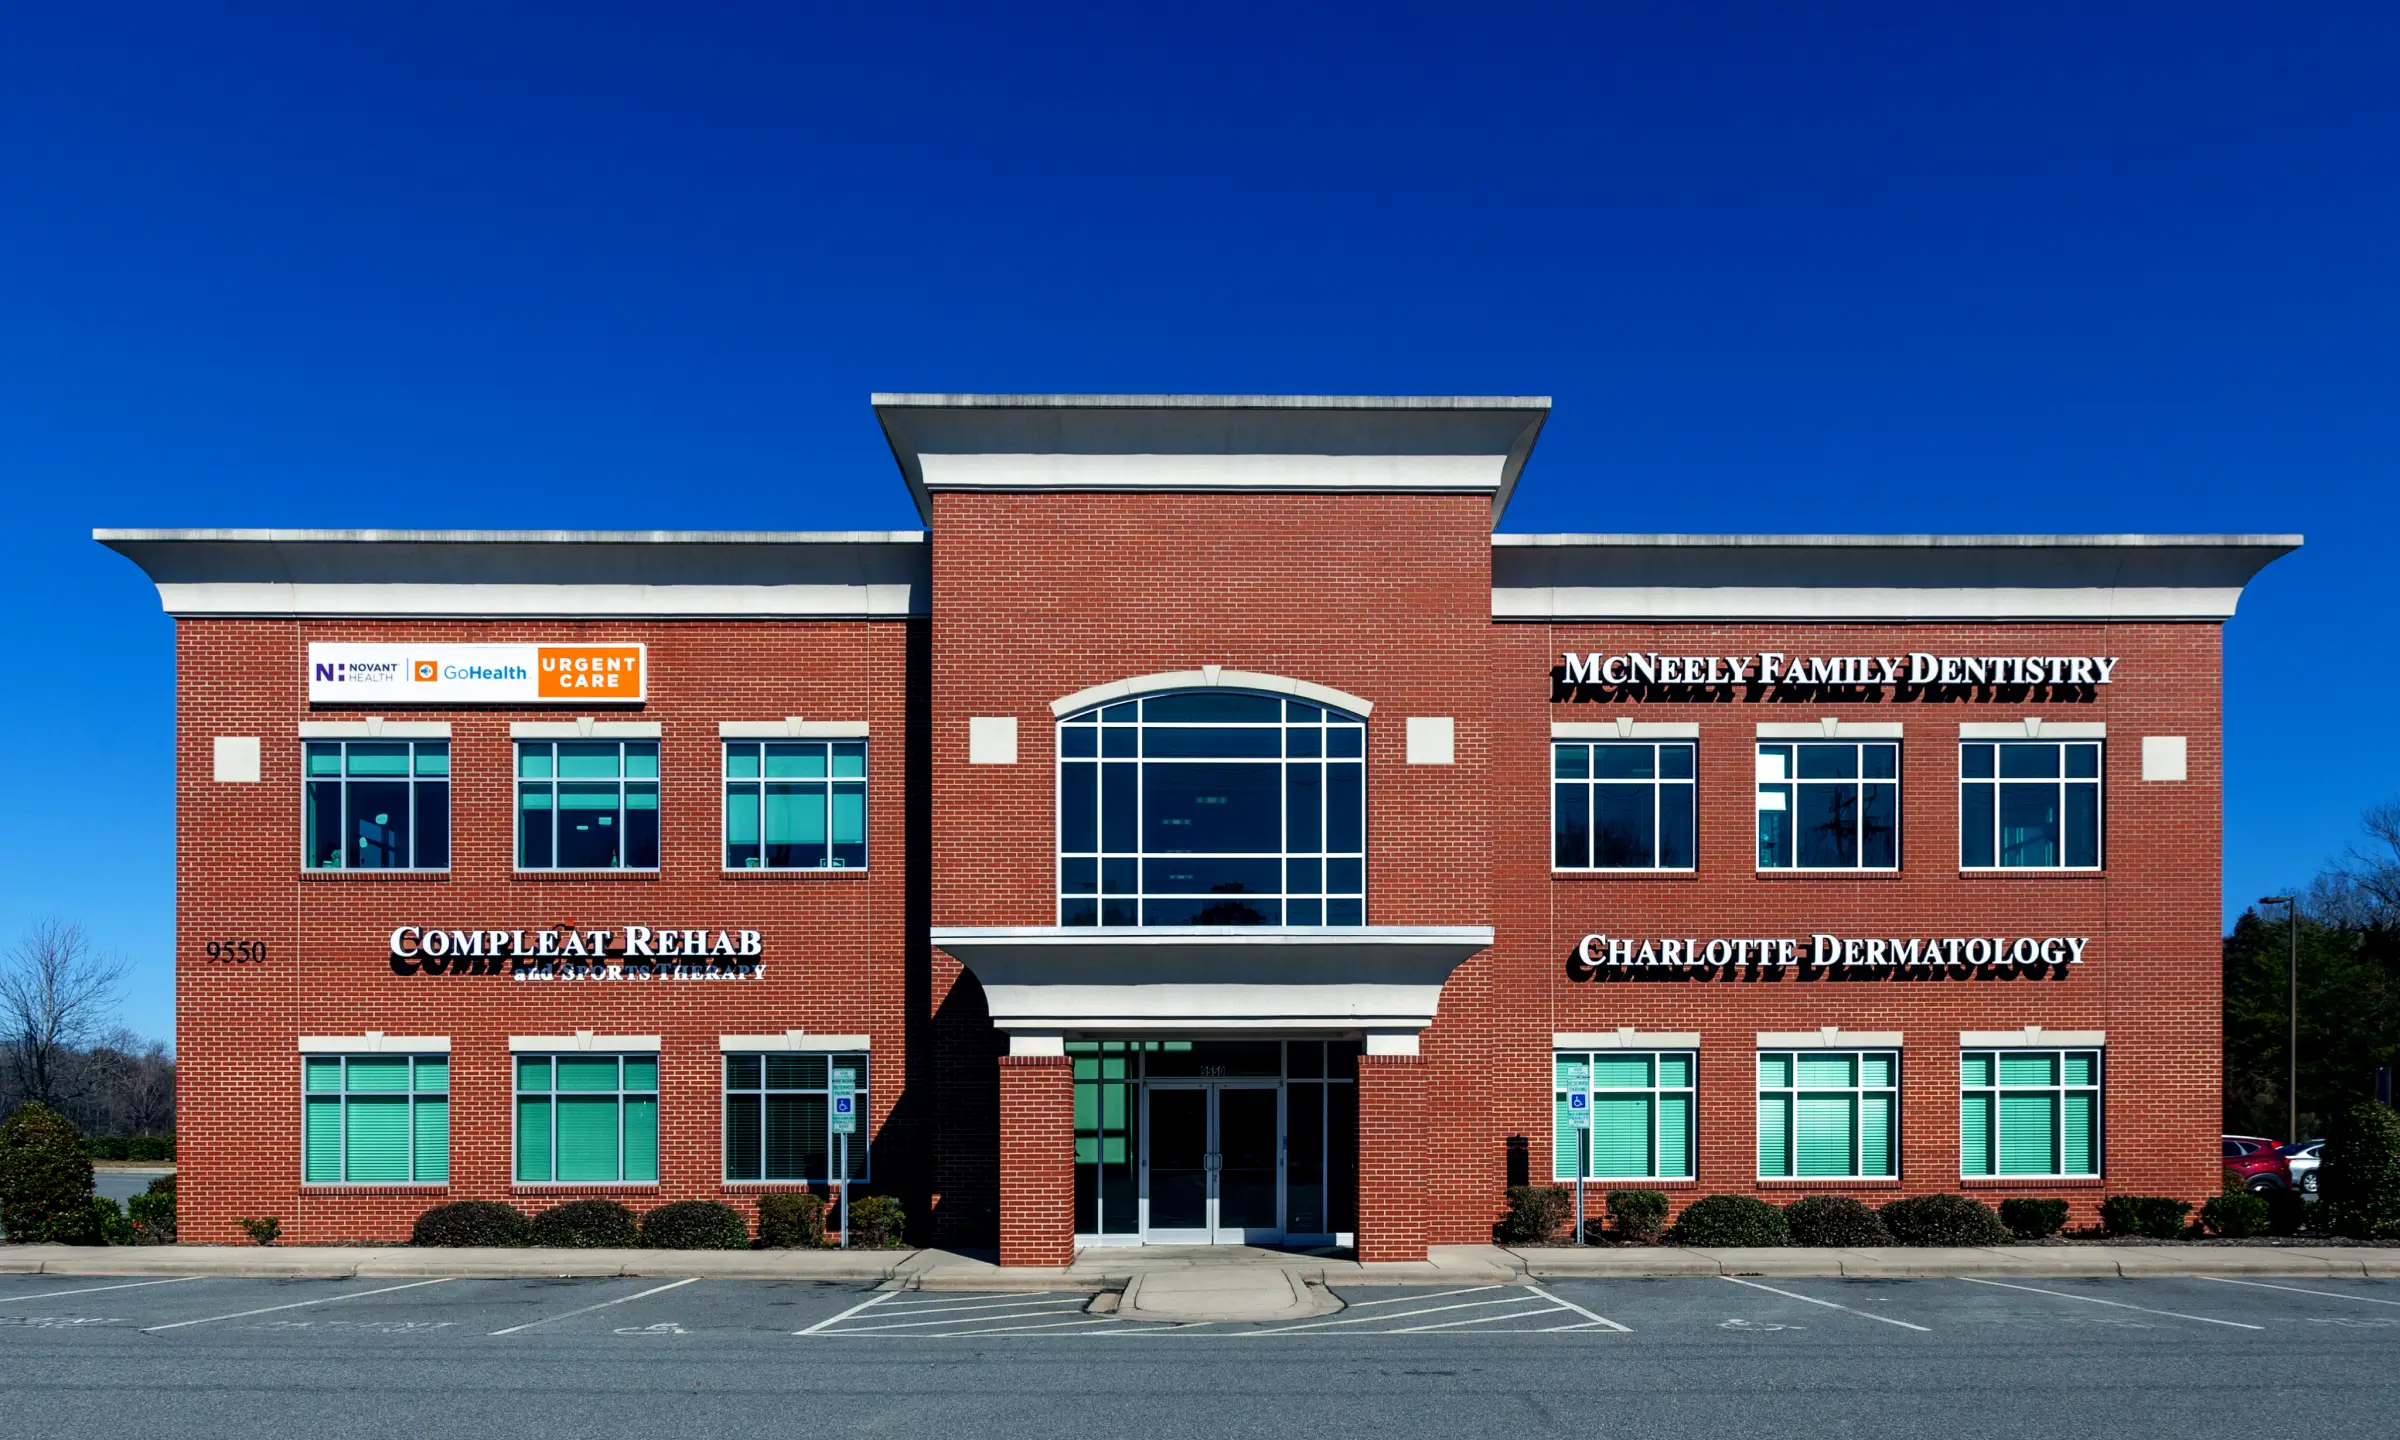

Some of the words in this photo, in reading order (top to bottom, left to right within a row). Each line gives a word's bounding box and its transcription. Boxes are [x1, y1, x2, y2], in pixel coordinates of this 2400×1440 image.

[349, 663, 398, 672] NOVANT
[444, 665, 527, 680] GoHealth
[542, 657, 635, 672] URGENT
[1758, 652, 1904, 684] FAMILY
[1907, 652, 2119, 684] DENTISTRY
[349, 673, 394, 682] HEALTH
[559, 674, 619, 688] CARE
[390, 926, 612, 958] COMPLEAT
[623, 926, 763, 957] REHAB
[1578, 934, 1799, 967] CHARLOTTE
[1811, 934, 2090, 967] DERMATOLOGY
[207, 941, 266, 963] 9550
[513, 964, 554, 983] and
[560, 962, 652, 983] SPORTS
[654, 963, 768, 983] THERAPY
